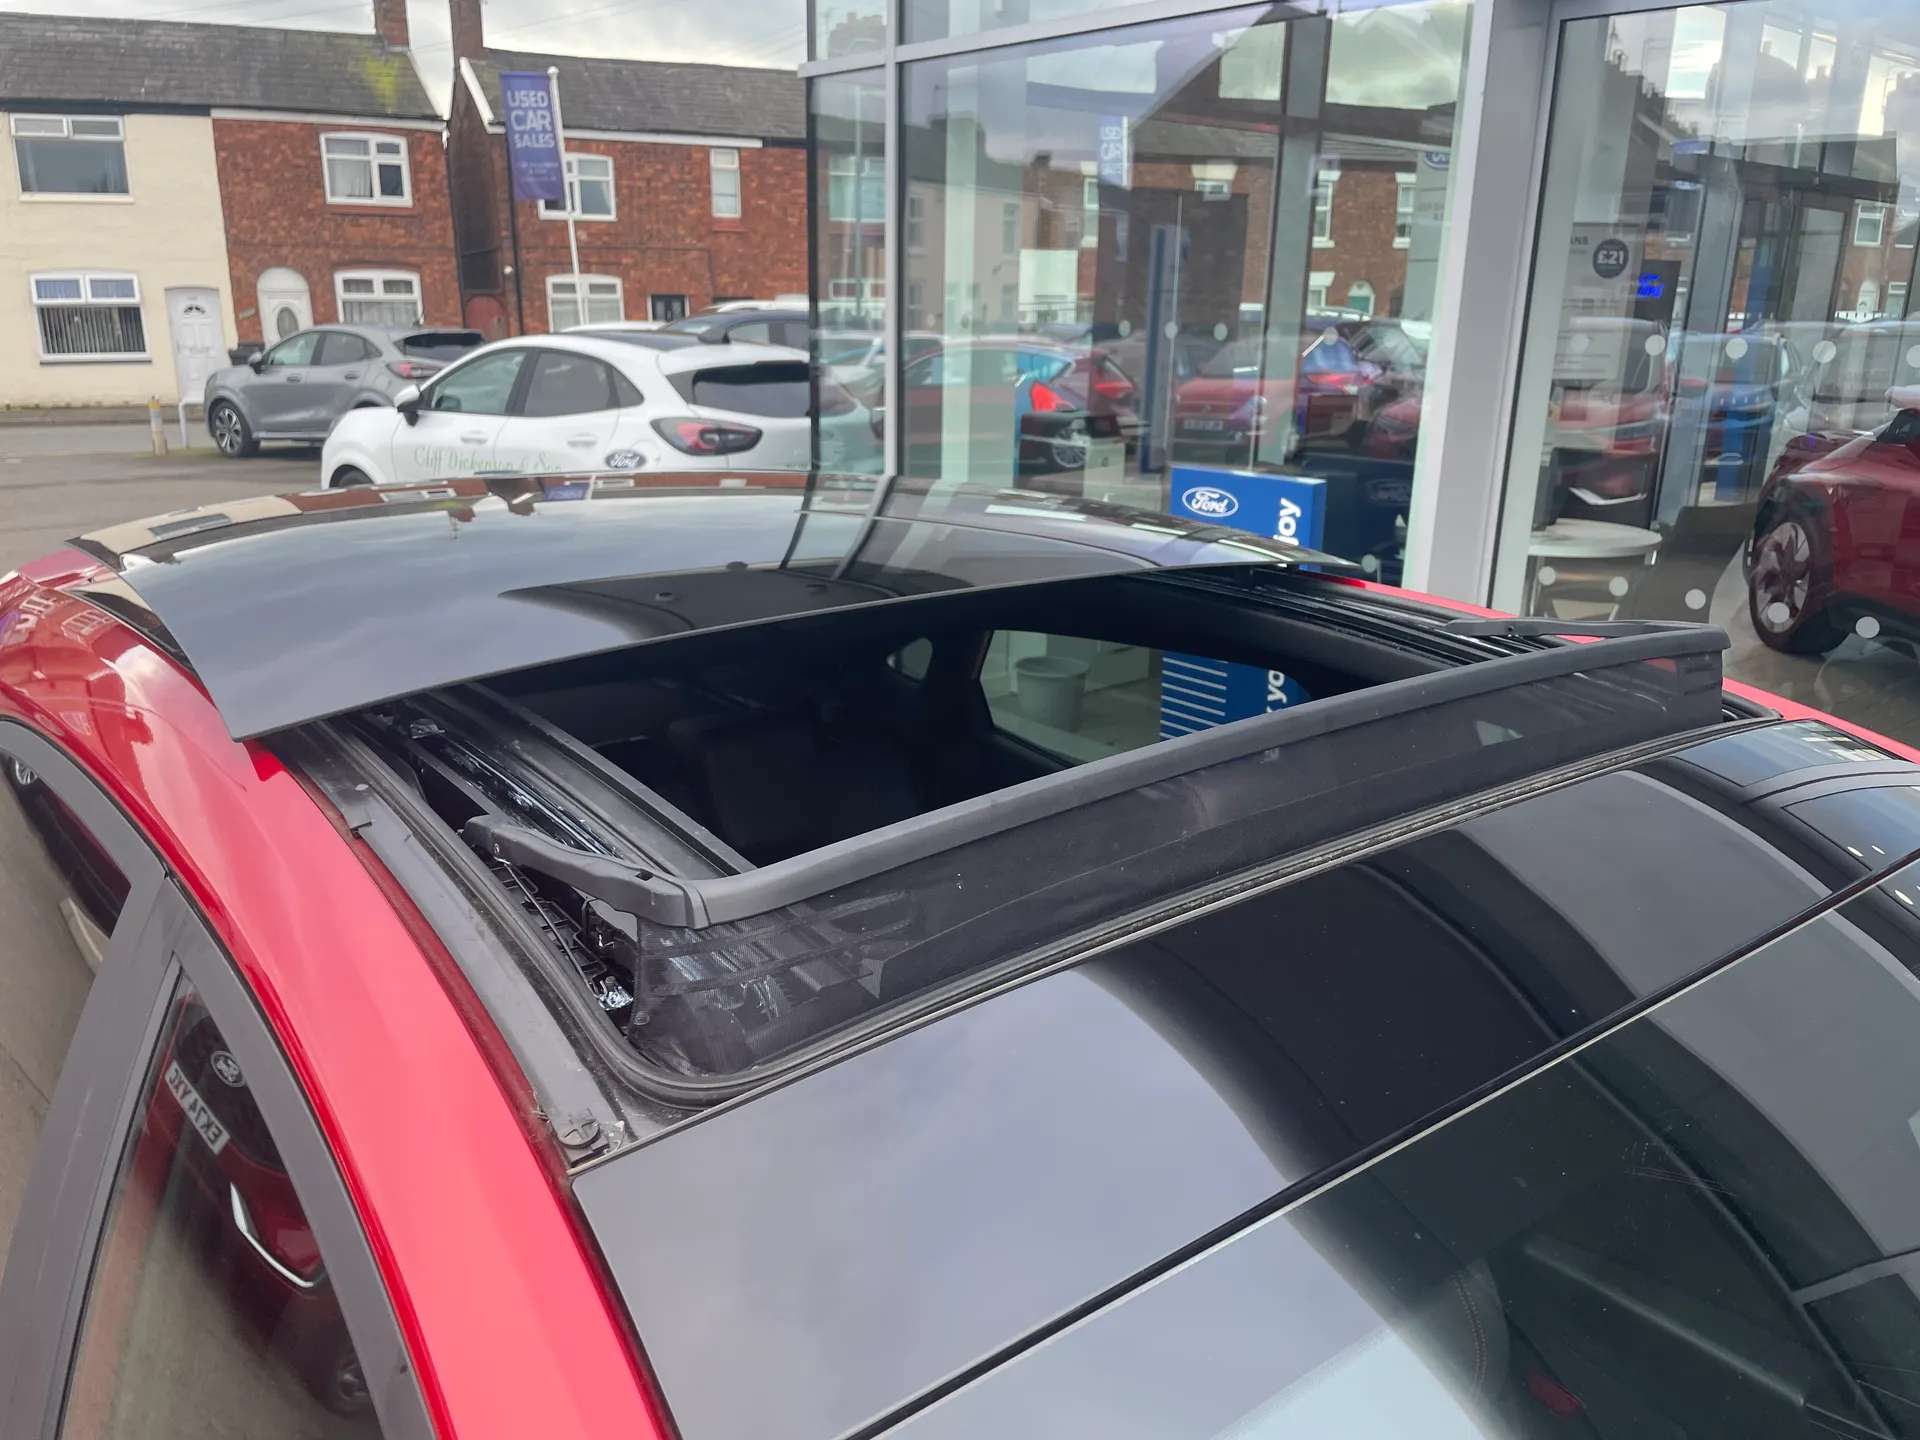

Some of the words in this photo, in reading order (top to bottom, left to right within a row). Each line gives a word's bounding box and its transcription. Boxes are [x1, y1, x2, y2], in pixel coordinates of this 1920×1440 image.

[506, 89, 549, 108] USED
[511, 109, 552, 131] CAR
[514, 133, 555, 149] SALES
[414, 444, 444, 475] Cliff
[533, 448, 562, 473] Son
[609, 452, 642, 468] Ford
[1189, 489, 1231, 515] Ford
